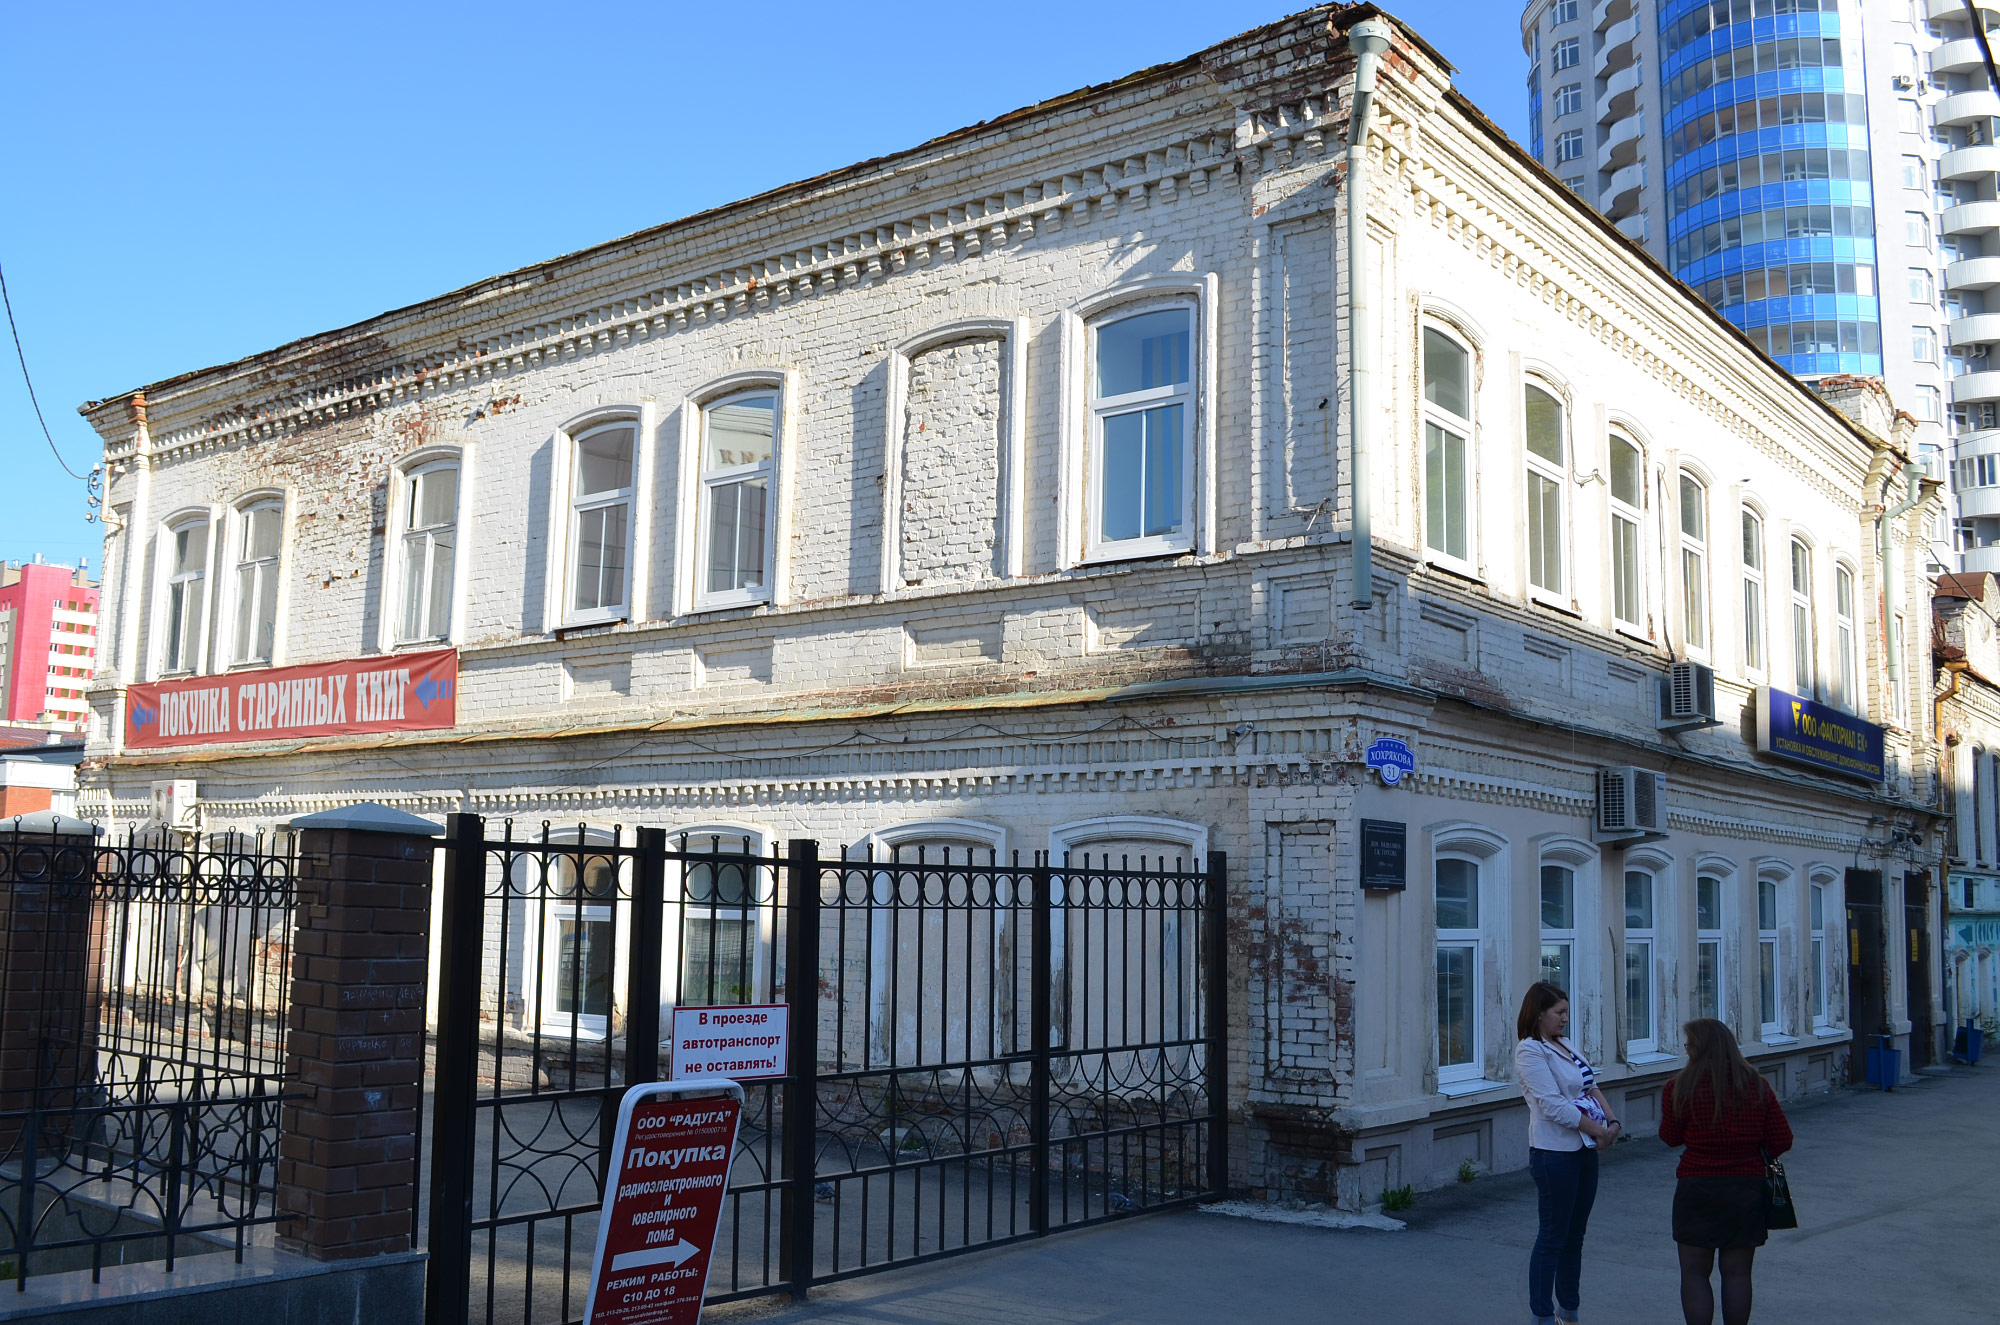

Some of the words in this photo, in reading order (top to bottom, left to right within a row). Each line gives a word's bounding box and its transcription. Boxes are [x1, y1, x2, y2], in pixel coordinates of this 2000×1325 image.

[159, 686, 230, 737] ПОКУПКА
[237, 674, 349, 731] СТАРИННЫХ
[355, 668, 412, 723] КНИГ
[1802, 713, 1817, 738] ООО
[1370, 750, 1412, 767] ХОХРЯКОВА
[1775, 736, 1802, 753] УСТАНОВКА
[1805, 744, 1839, 764] ОБСЛУЖИВАНИЕ
[1387, 766, 1395, 778] 31
[699, 1013, 708, 1026] В
[712, 1013, 768, 1027] проезде
[682, 1035, 781, 1051] автотранспорт
[685, 1062, 703, 1074] не
[707, 1055, 777, 1073] оставлять!
[637, 1116, 666, 1130] ООО
[669, 1110, 732, 1128] “РАДУГА”
[627, 1144, 726, 1170] Покупка
[618, 1173, 723, 1202] радиоэлектронного
[664, 1194, 671, 1206] и
[632, 1205, 697, 1226] ювелирного
[646, 1227, 675, 1245] лома
[606, 1275, 646, 1291] РЕЖИМ
[650, 1267, 699, 1283] РАБОТЫ:
[623, 1292, 643, 1303] С10
[644, 1288, 661, 1301] ДО
[663, 1286, 676, 1296] 18
